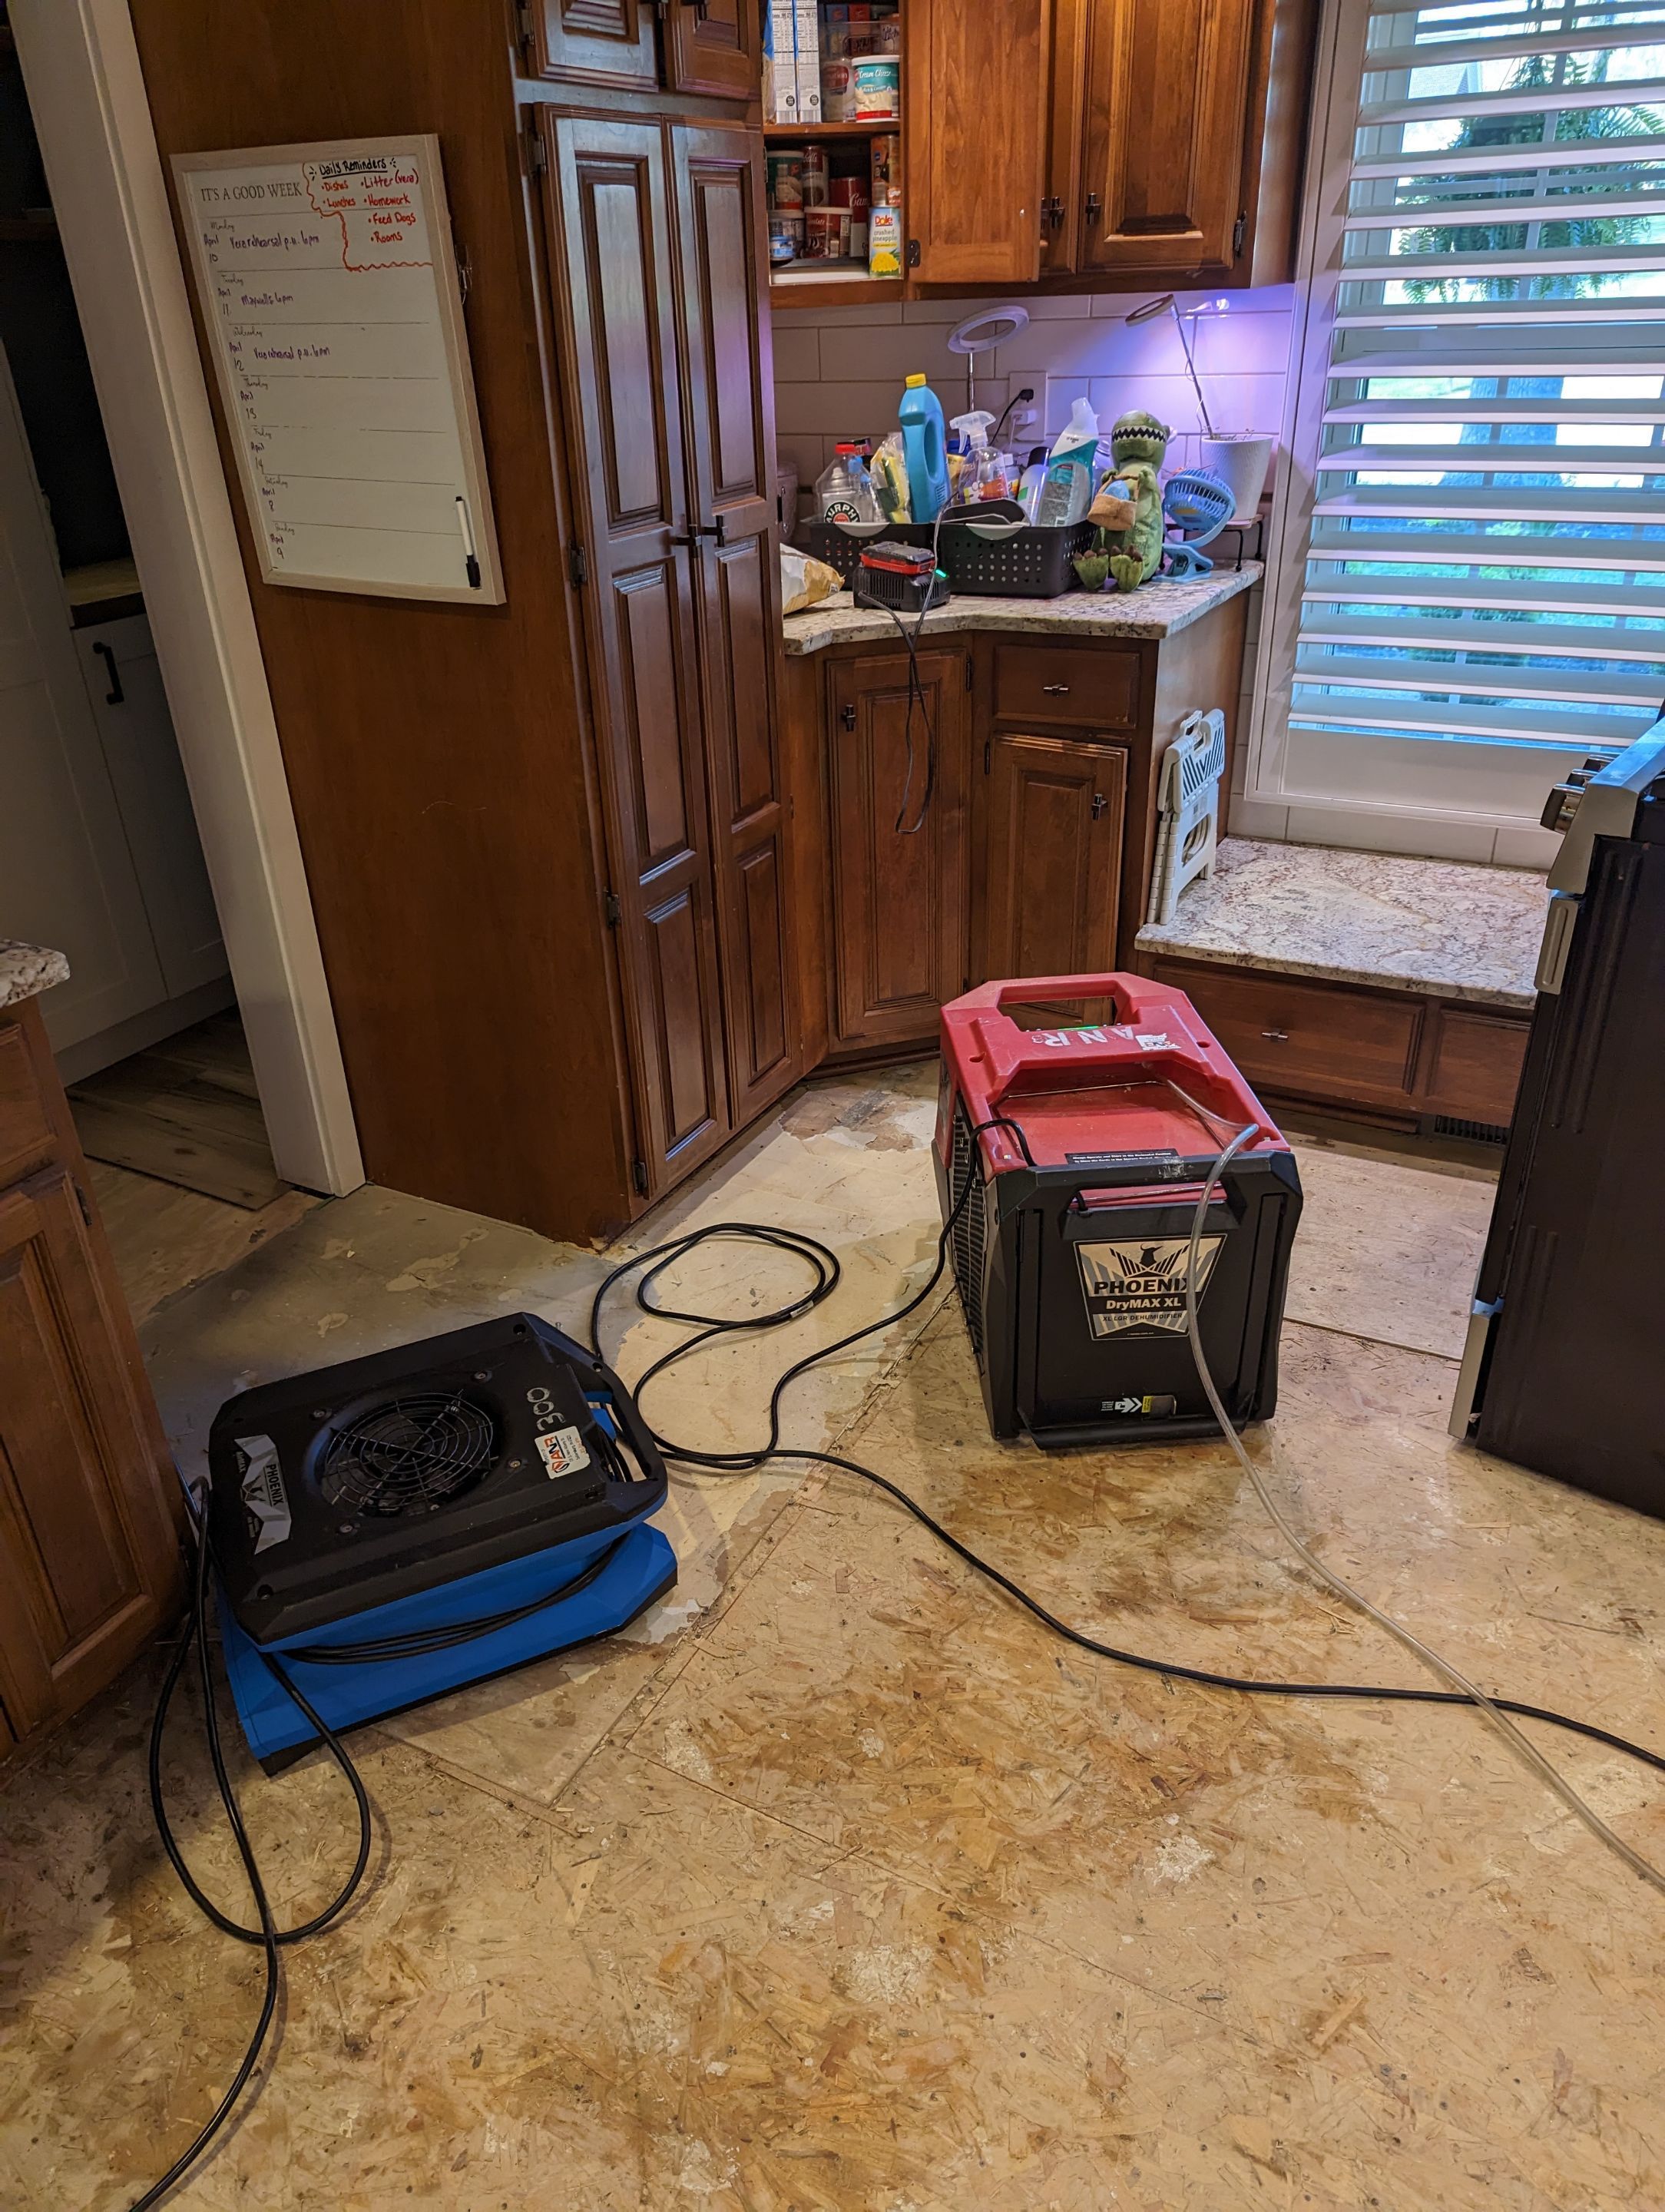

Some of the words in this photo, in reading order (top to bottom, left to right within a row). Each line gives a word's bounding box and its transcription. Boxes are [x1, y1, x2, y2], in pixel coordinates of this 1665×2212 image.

[319, 161, 342, 176] Daily
[343, 158, 386, 171] Reminders
[324, 180, 349, 191] Dishes
[364, 176, 393, 189] Litter
[223, 187, 230, 200] A
[233, 185, 265, 200] GOOD
[266, 182, 302, 197] WEEK
[368, 193, 411, 207] Homework
[372, 213, 392, 225] Feed
[395, 212, 416, 225] Dogs
[875, 215, 892, 225] Dole
[374, 231, 402, 243] Rooms
[209, 253, 218, 263] 10
[1106, 1299, 1161, 1311] DryMAX
[1164, 1297, 1182, 1307] XL
[1130, 1313, 1183, 1321] DEHUMIDIFIER
[527, 1387, 566, 1432] 300
[266, 1463, 284, 1506] PHOENIX
